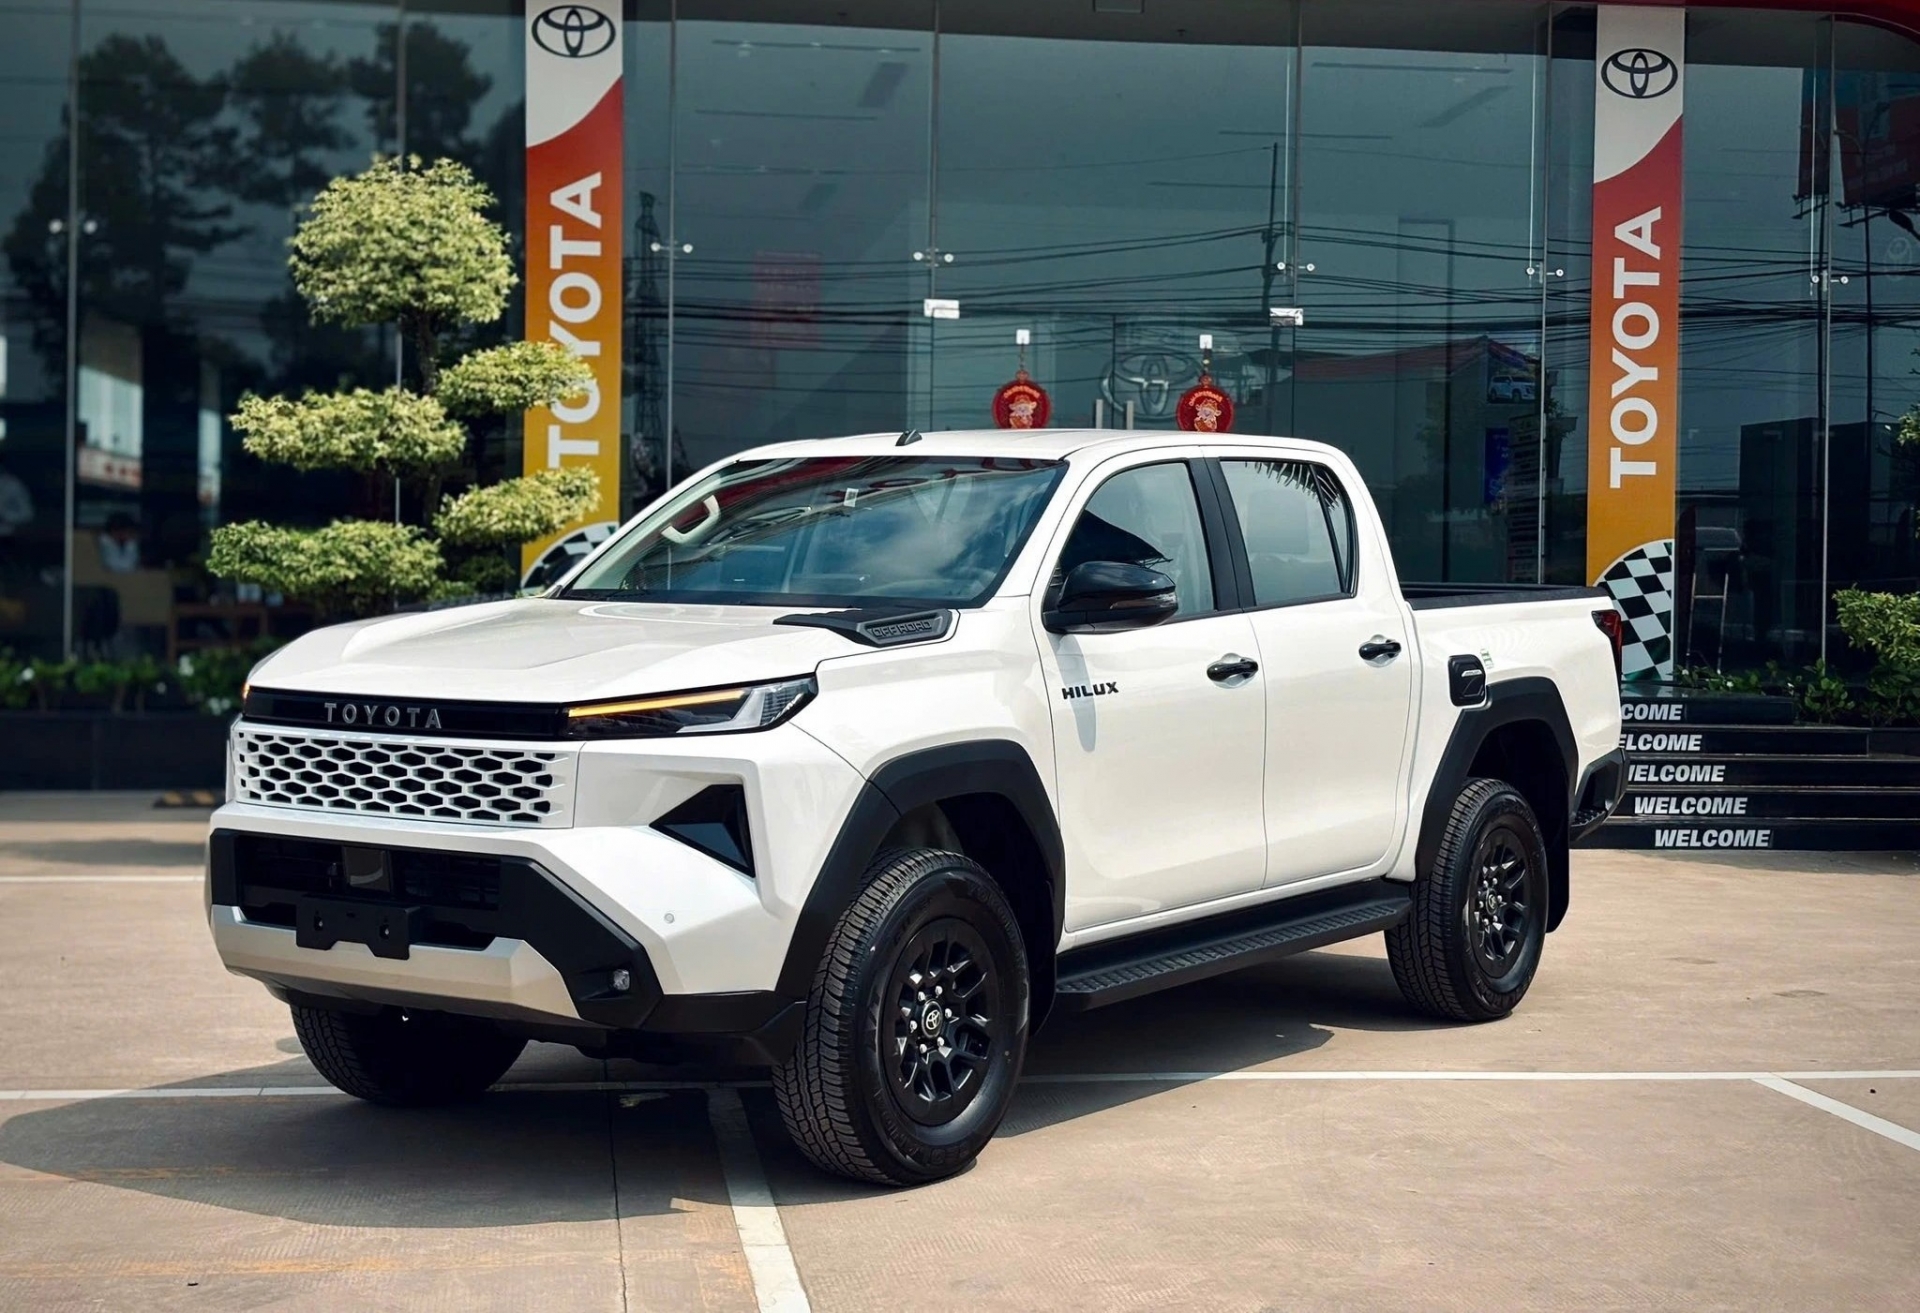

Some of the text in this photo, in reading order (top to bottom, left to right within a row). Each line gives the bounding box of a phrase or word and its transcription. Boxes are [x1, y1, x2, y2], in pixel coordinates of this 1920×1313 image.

[1609, 206, 1662, 489] TOYOTA
[1061, 681, 1119, 700] HILUX
[324, 702, 442, 729] TOYOTA
[1628, 764, 1726, 782] ELCOME
[1634, 796, 1748, 815] WELCOME
[1654, 829, 1771, 847] WELCOME
